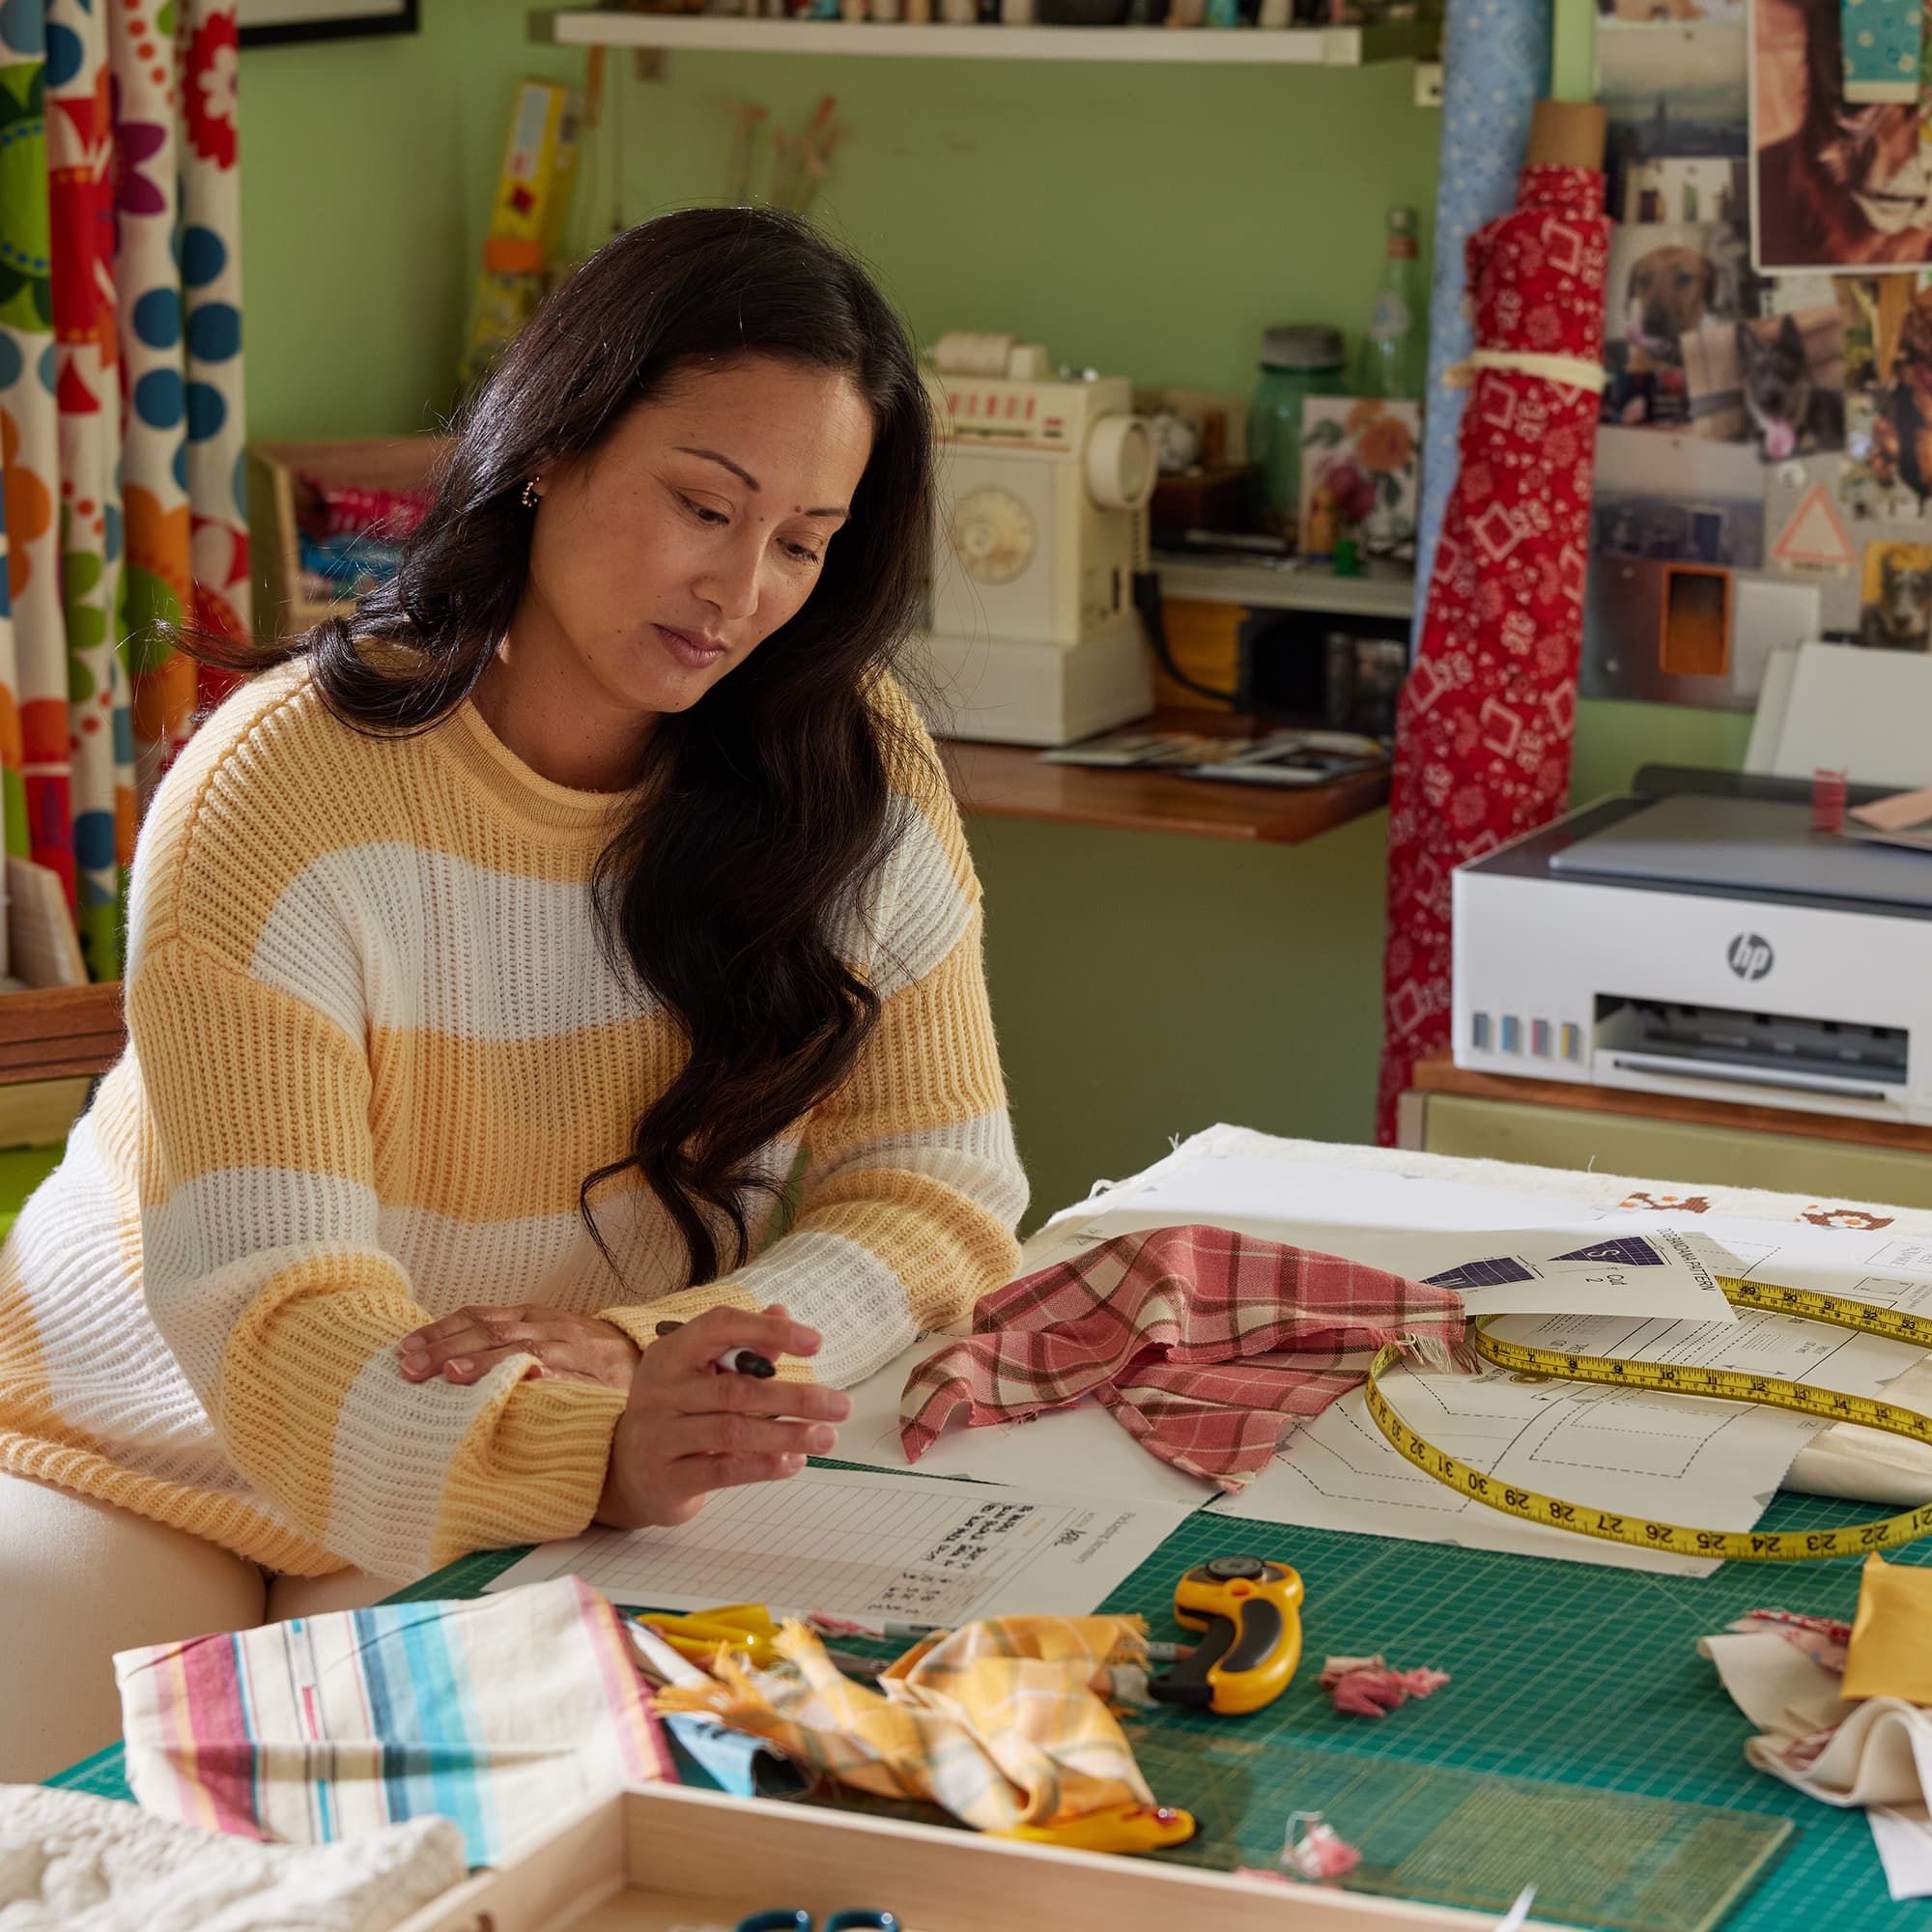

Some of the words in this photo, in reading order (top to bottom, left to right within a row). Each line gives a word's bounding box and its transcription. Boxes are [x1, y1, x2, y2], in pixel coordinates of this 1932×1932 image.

[1727, 933, 1774, 981] hp
[1684, 1259, 1717, 1291] PATTERN
[1740, 1285, 1756, 1295] 49
[1782, 1293, 1798, 1302] 50
[1824, 1300, 1835, 1311] 51
[1862, 1310, 1878, 1321] 52
[1901, 1319, 1916, 1330] 53
[1527, 1352, 1536, 1363] 7
[1569, 1360, 1577, 1369] 8
[1613, 1365, 1623, 1375] 9
[1662, 1371, 1675, 1380] 10
[1708, 1376, 1718, 1384] 11
[1752, 1382, 1766, 1392] 12
[1794, 1390, 1807, 1401] 13
[1834, 1399, 1847, 1409] 14
[1876, 1407, 1888, 1418] 15
[1392, 1419, 1403, 1442] 33
[1409, 1436, 1426, 1461] 32
[1438, 1456, 1454, 1478] 31
[1468, 1473, 1489, 1495] 30
[1505, 1489, 1530, 1511] 29
[1549, 1502, 1576, 1522] 28
[1597, 1515, 1624, 1534] 27
[1645, 1524, 1673, 1544] 26
[1695, 1533, 1726, 1550] 25
[1750, 1536, 1781, 1553] 24
[1806, 1533, 1836, 1551] 23
[1860, 1524, 1889, 1545] 22
[1912, 1508, 1932, 1531] 21
